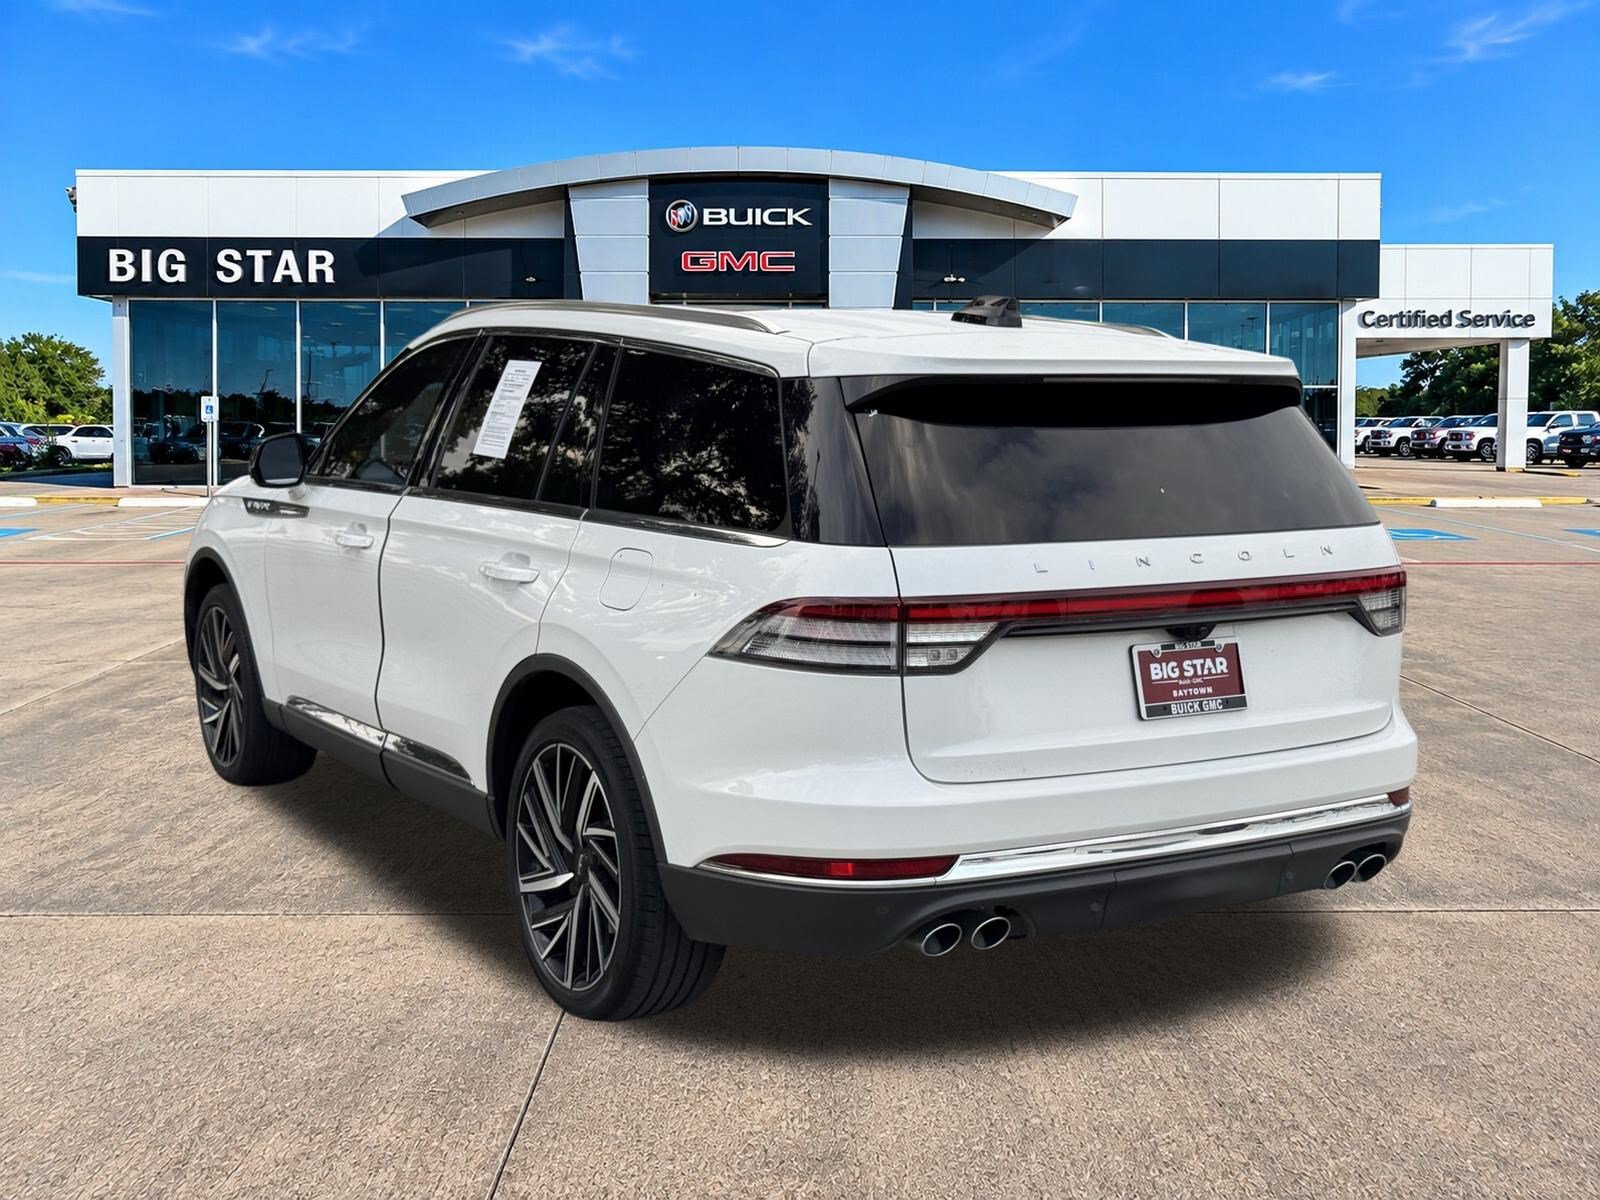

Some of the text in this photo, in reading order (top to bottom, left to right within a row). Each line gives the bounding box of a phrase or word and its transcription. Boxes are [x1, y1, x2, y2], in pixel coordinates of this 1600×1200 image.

[703, 207, 813, 226] BUICK
[108, 248, 336, 284] BIG STAR
[681, 250, 796, 272] GMC
[1360, 309, 1536, 328] Certified Service
[1034, 544, 1334, 574] LINCOLN
[1149, 656, 1229, 680] BIG STAR
[1172, 686, 1213, 697] BAYTOWN
[1170, 699, 1223, 715] BUICK GMC
